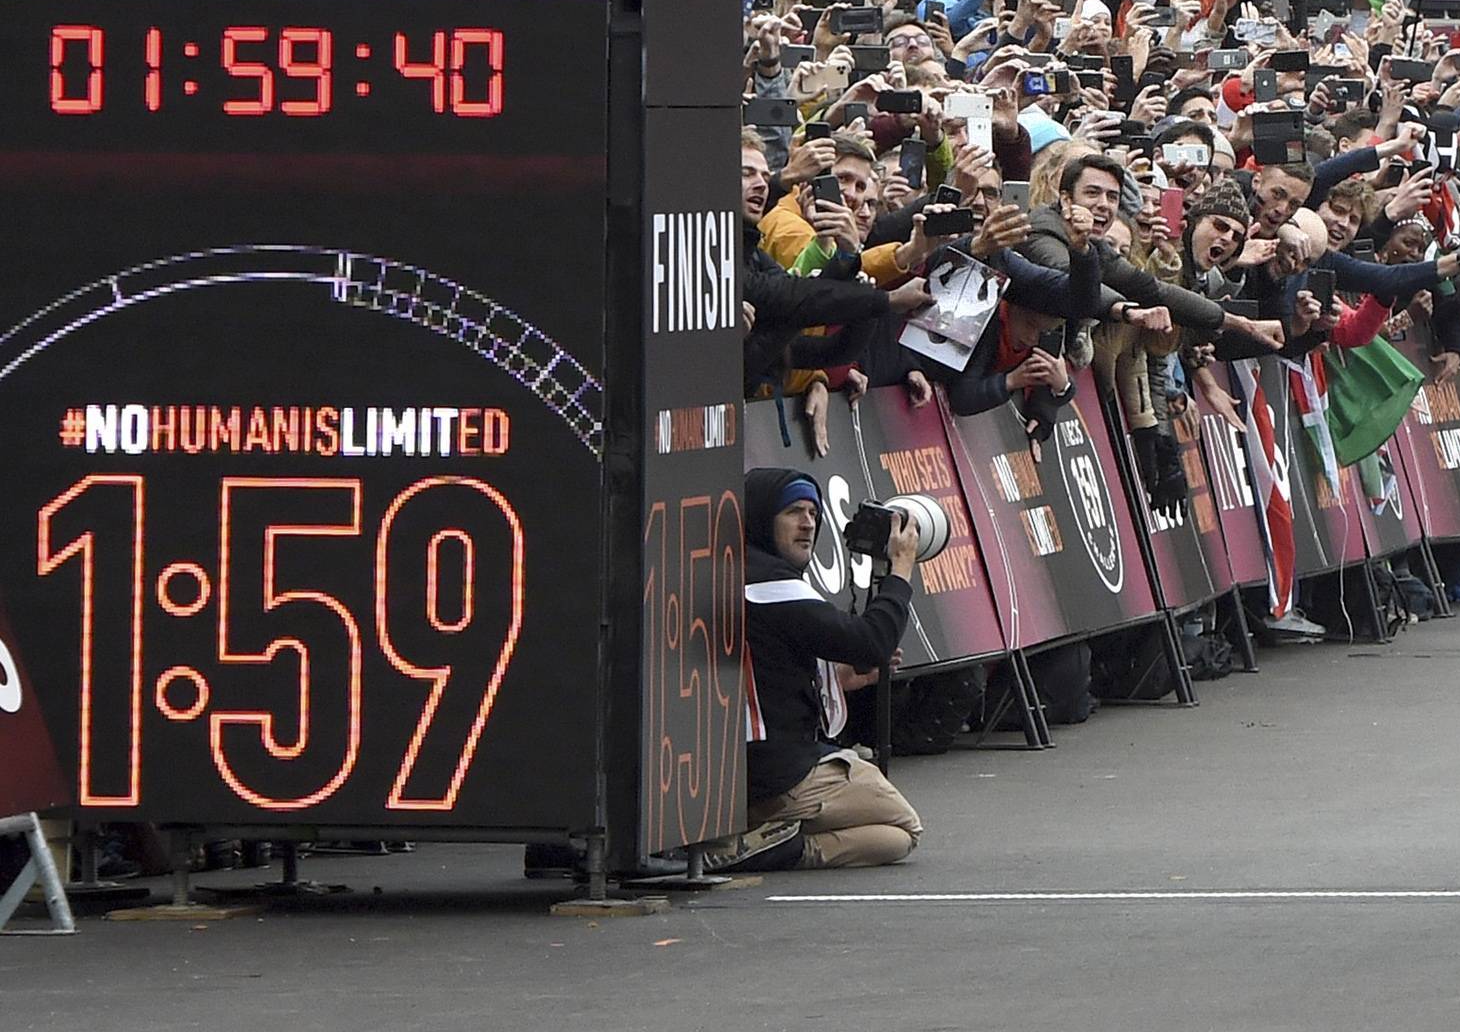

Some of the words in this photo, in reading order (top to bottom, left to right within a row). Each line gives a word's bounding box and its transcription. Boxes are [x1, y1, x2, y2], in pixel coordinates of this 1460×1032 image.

[50, 25, 505, 116] 01:59:40
[653, 211, 735, 333] FINISH
[60, 405, 511, 458] #NOHUMANISLIMITED
[914, 446, 951, 491] SETS
[37, 475, 524, 812] 1:59
